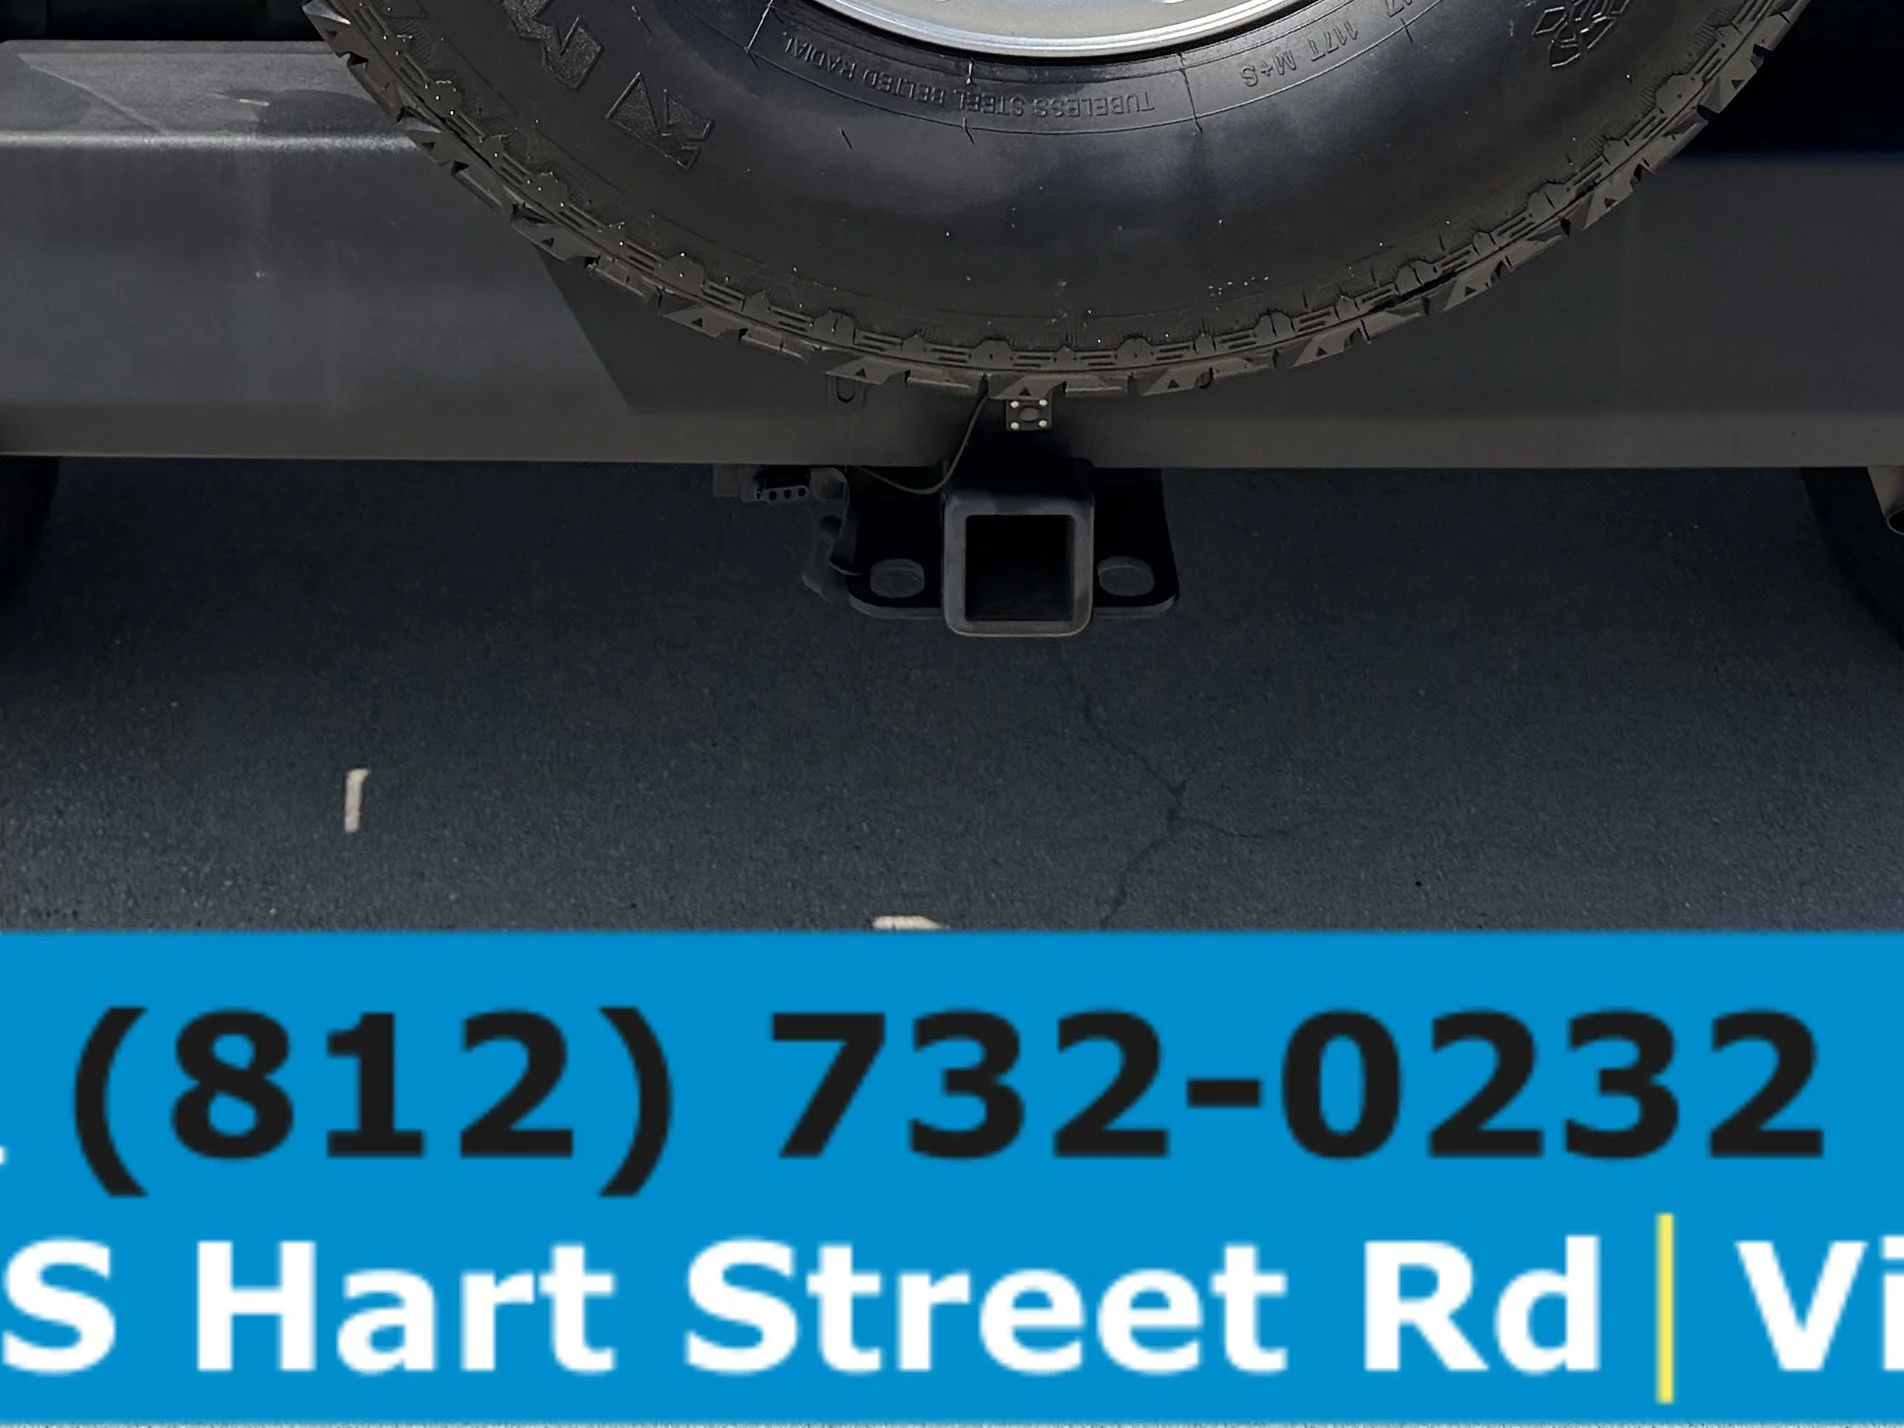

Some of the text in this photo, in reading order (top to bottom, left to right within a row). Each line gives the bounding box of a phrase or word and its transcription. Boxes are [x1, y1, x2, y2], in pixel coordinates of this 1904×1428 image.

[782, 33, 1157, 118] TUBELESS STEEL BELTED RADIAL
[1237, 16, 1363, 90] 117T M+S
